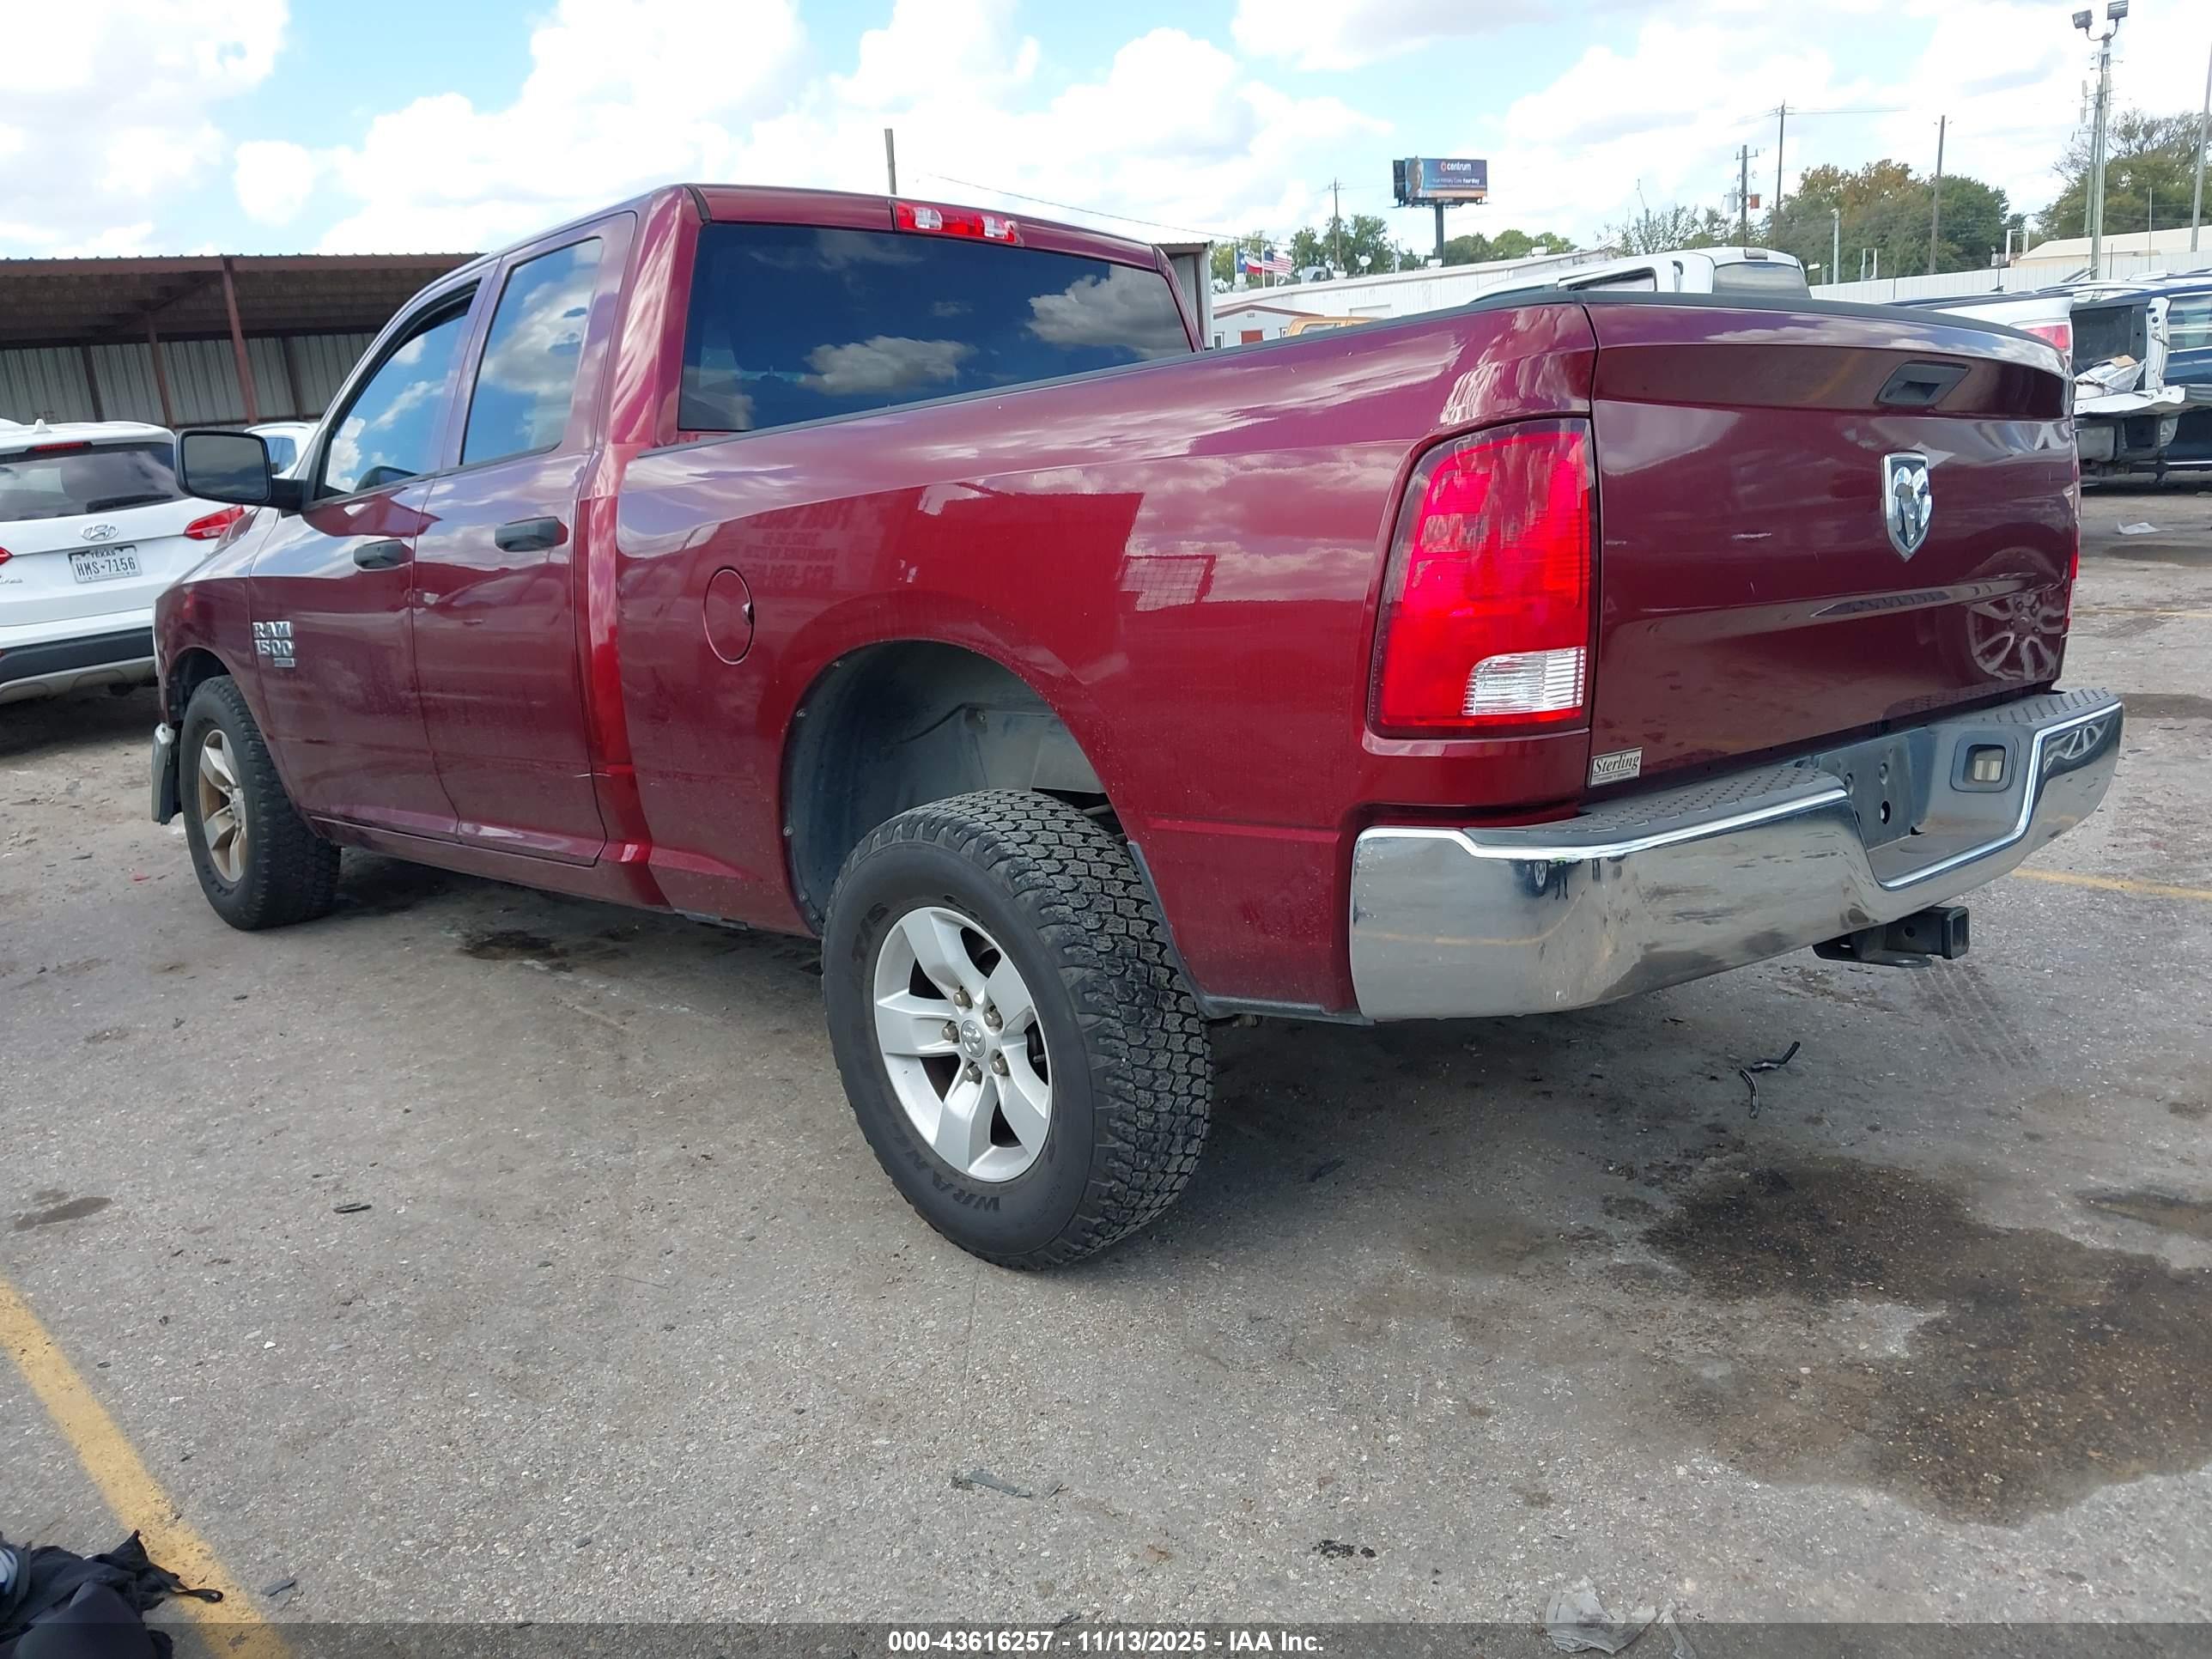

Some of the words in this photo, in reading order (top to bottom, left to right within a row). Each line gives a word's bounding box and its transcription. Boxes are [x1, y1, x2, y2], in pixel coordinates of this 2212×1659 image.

[90, 550, 116, 558] TEXAS
[252, 621, 292, 638] RAM
[254, 640, 295, 656] 1500
[1595, 754, 1640, 774] Sterling
